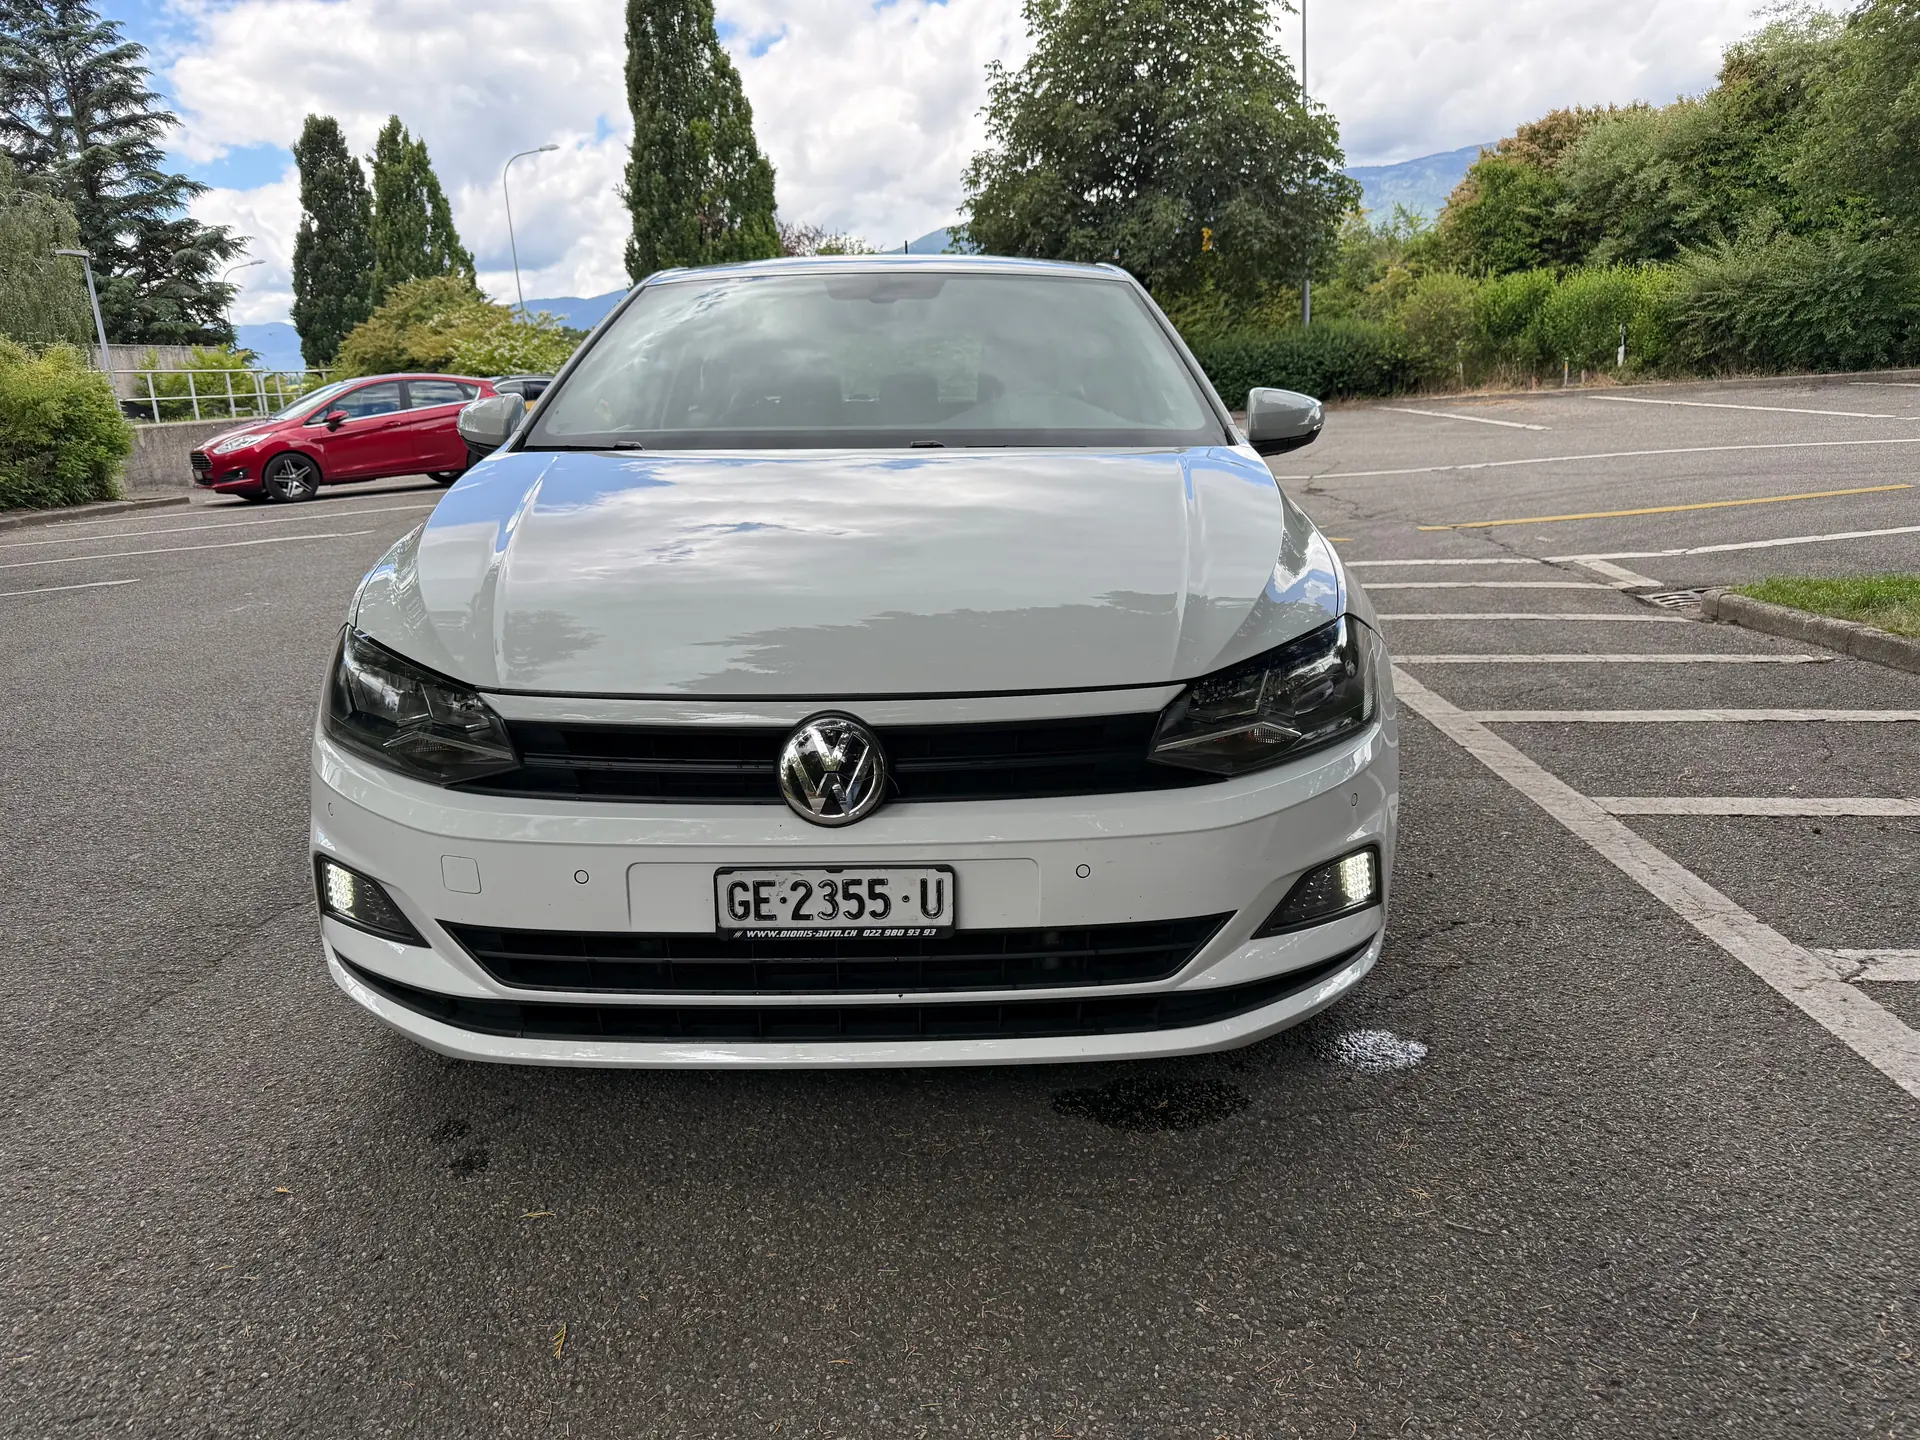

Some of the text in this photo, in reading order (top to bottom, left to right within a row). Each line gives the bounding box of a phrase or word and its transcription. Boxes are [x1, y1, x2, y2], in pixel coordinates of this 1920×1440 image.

[783, 722, 880, 820] VW
[746, 928, 937, 938] WWW.DIONIS-AUTO.CH 022 980 93 93
